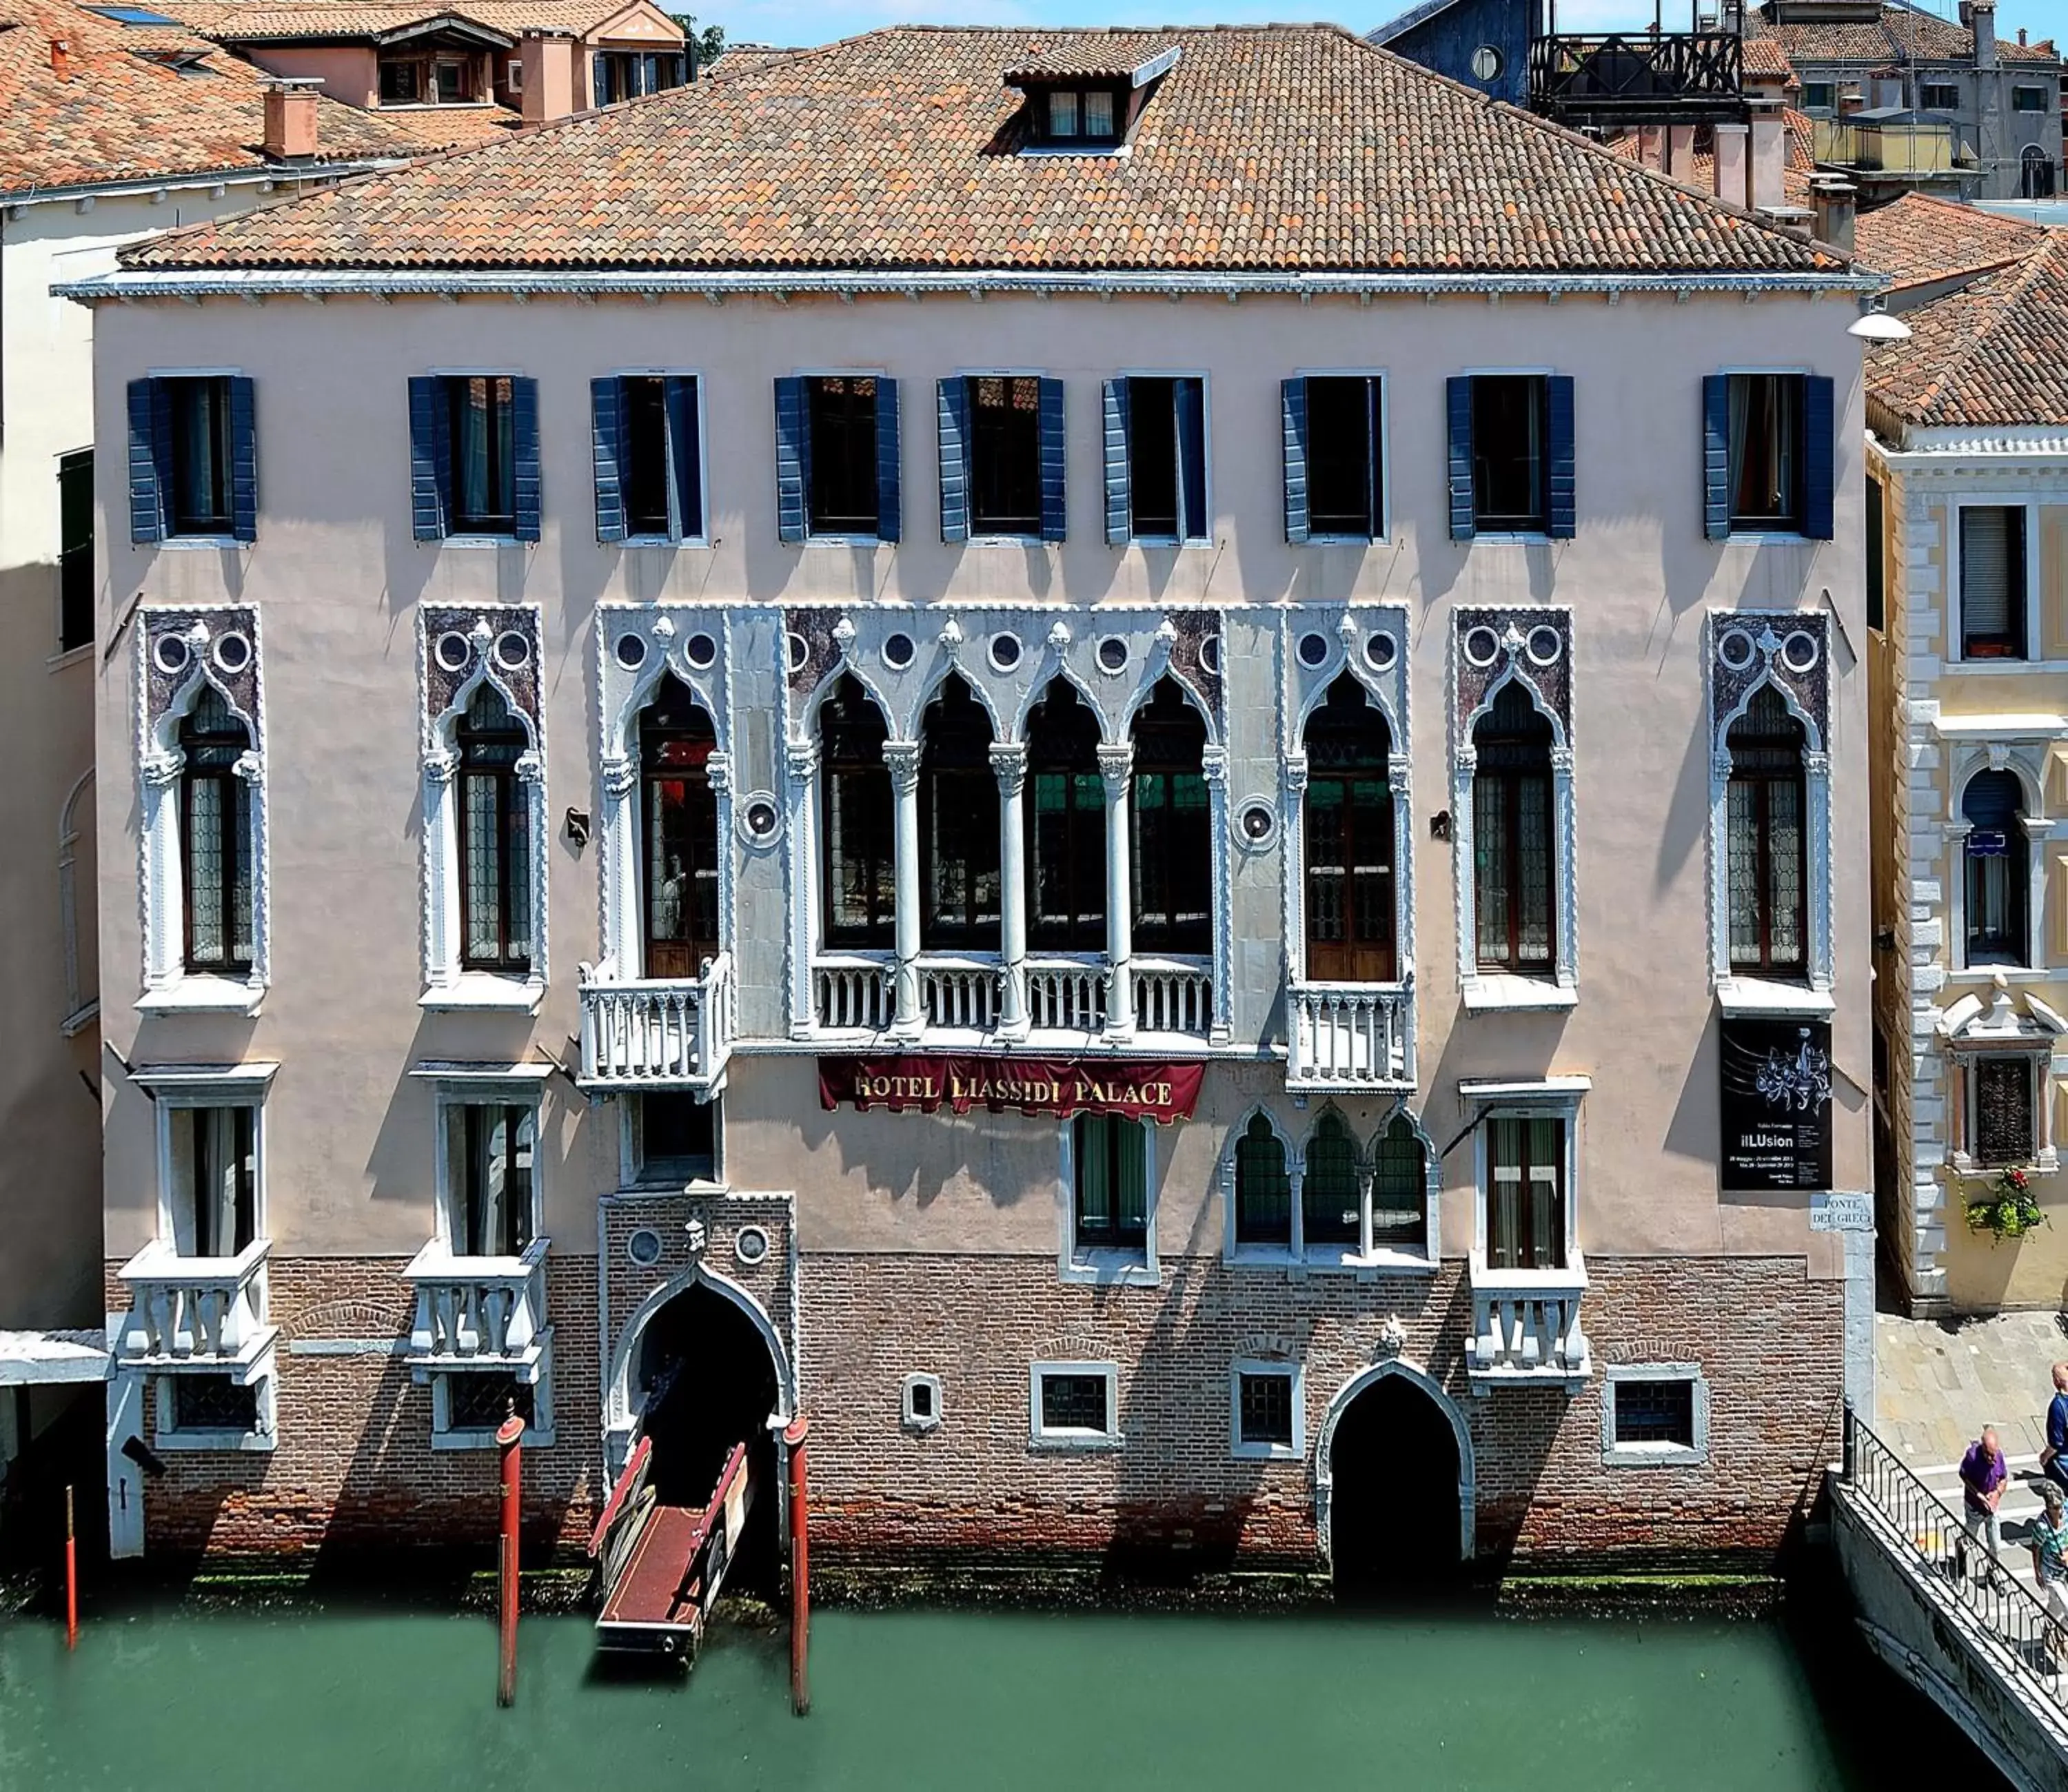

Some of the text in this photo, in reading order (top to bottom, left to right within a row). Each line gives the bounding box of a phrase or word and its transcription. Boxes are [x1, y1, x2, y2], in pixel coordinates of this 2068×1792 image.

[855, 1076, 1173, 1106] HOTEL LIASSIDI PALACE
[1825, 1199, 1861, 1209] PONTE
[1837, 1213, 1871, 1223] GRECI
